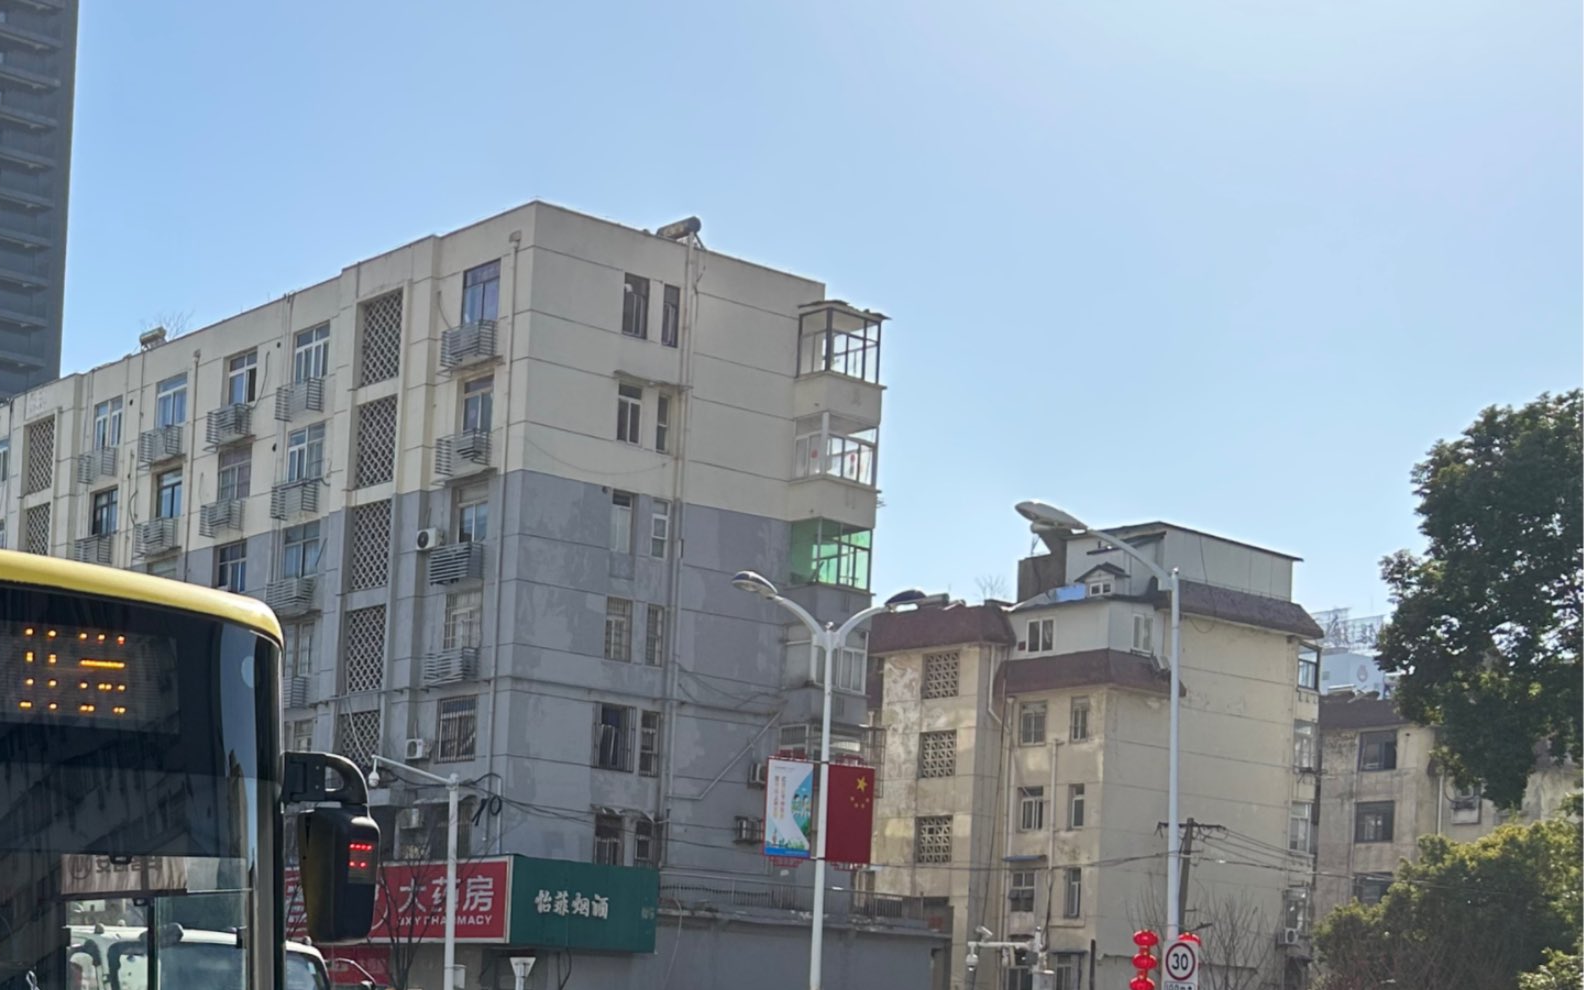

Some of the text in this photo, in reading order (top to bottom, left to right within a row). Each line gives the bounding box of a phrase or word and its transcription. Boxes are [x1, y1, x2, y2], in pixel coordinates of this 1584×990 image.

[397, 875, 494, 912] 大药房
[534, 889, 609, 919] 怡菲烟酒
[1172, 953, 1188, 971] 30
